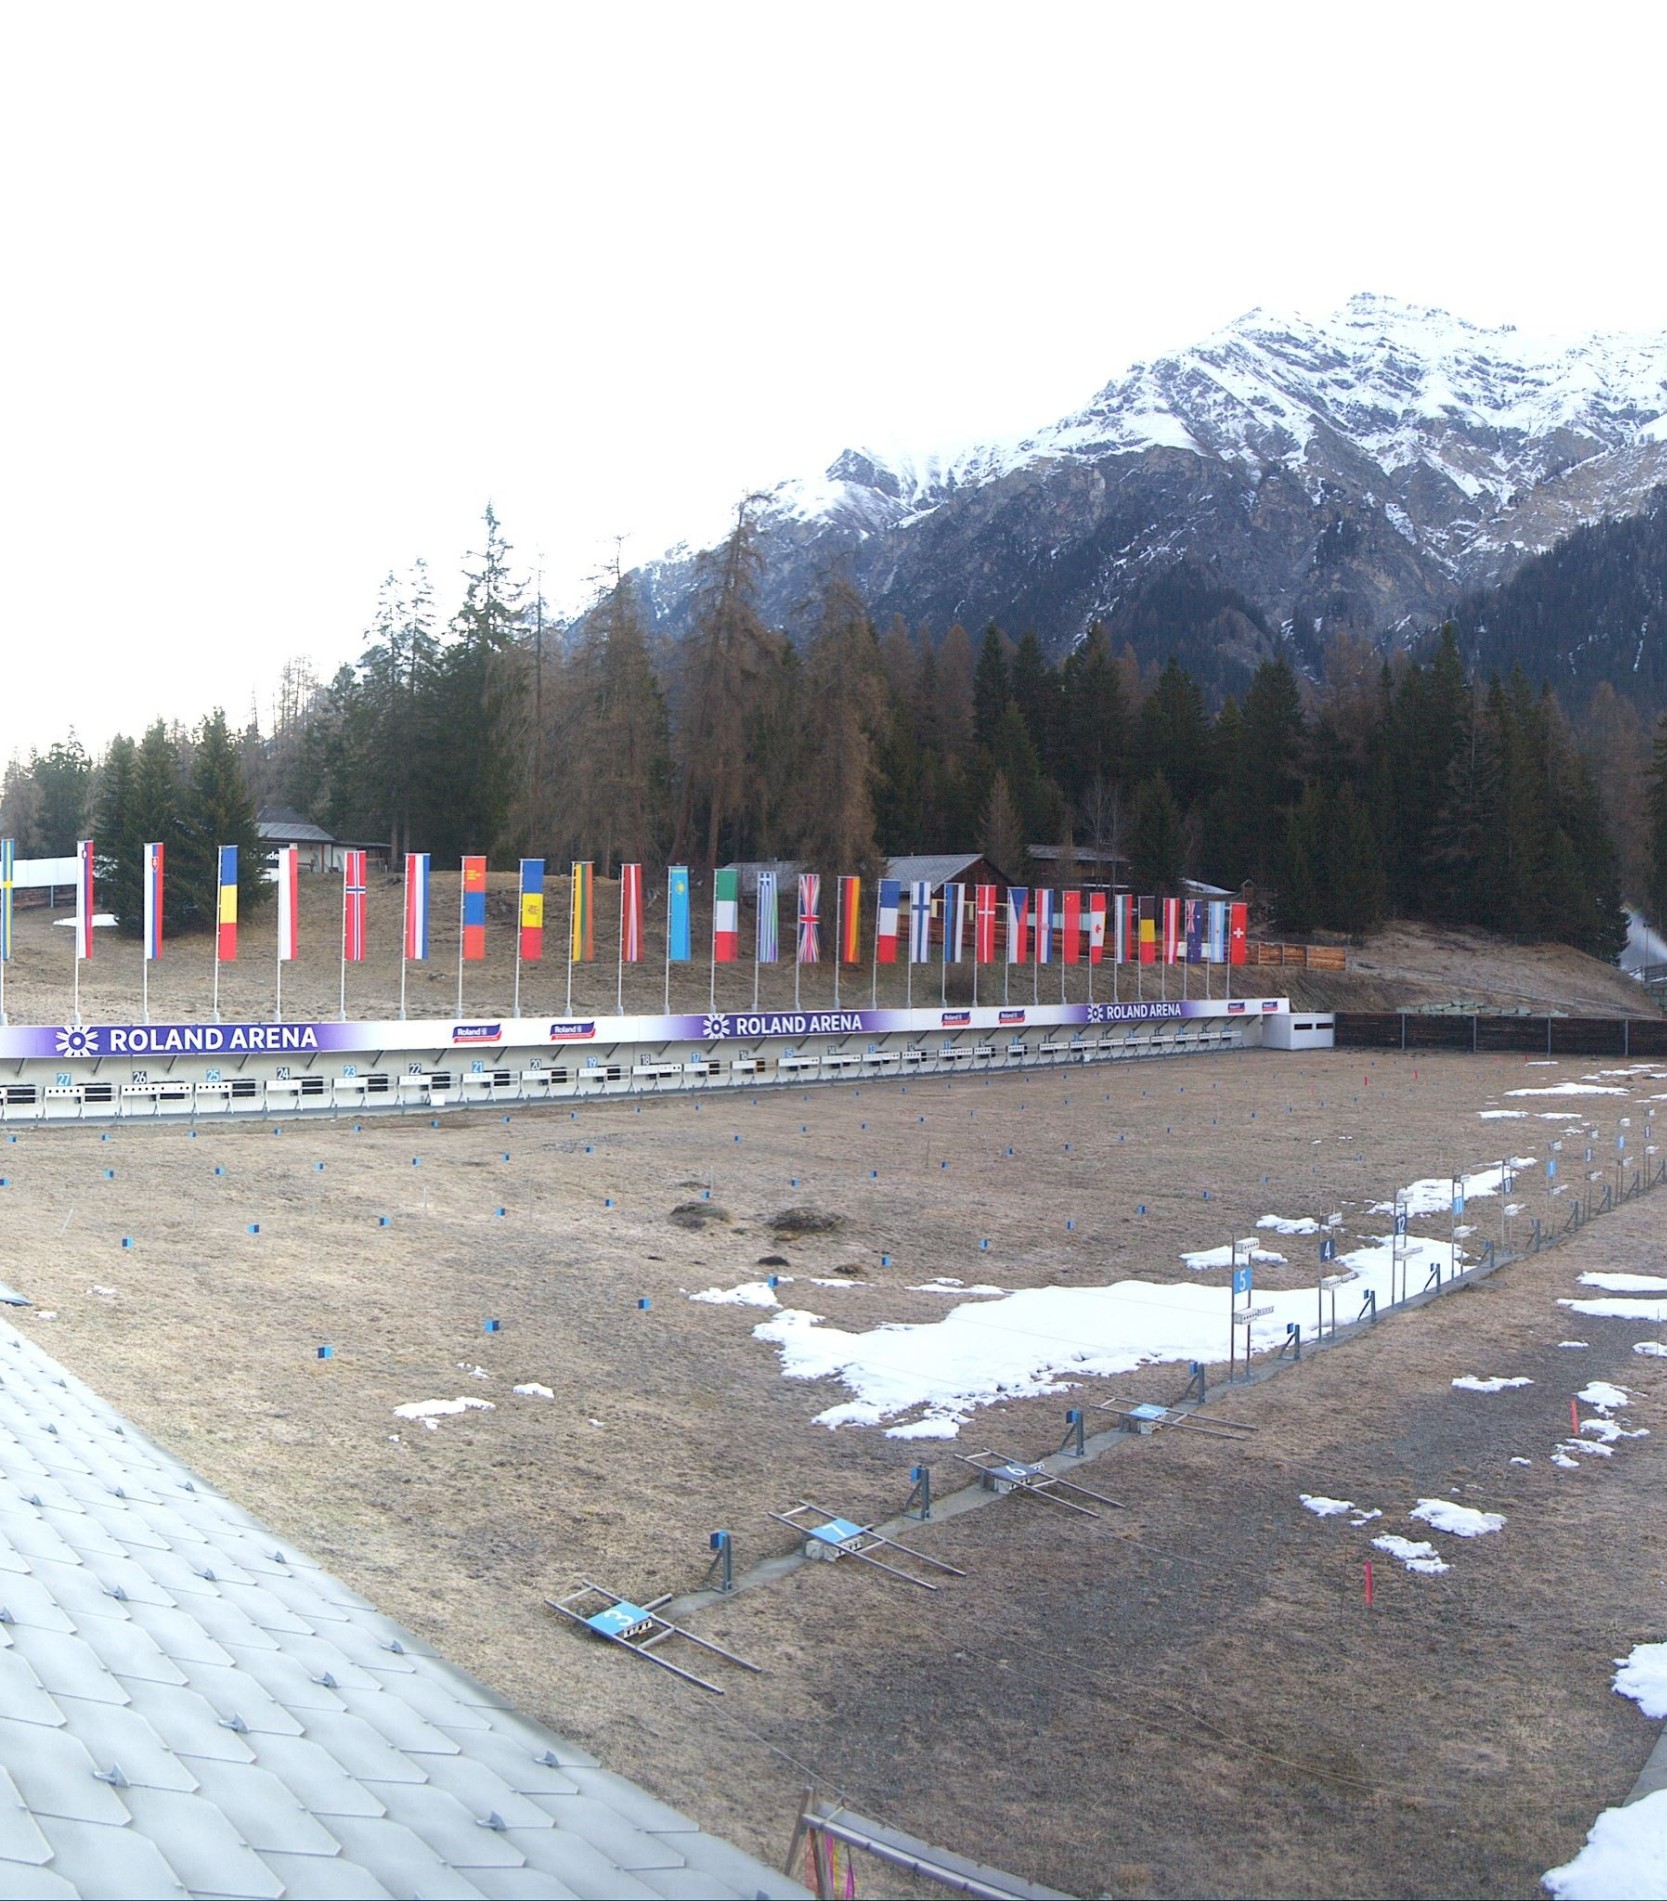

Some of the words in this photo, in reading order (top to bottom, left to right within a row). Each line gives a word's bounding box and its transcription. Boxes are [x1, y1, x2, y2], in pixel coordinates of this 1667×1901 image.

[1107, 1005, 1148, 1019] ROLAND
[1149, 1003, 1182, 1017] ARENA
[555, 1026, 576, 1034] Roland
[736, 1016, 806, 1035] ROLAND
[809, 1014, 863, 1032] ARENA
[457, 1028, 481, 1036] Roland
[110, 1028, 223, 1051] ROLAND
[229, 1027, 318, 1050] ARENA
[344, 1065, 356, 1077] 23
[410, 1064, 421, 1074] 22
[473, 1062, 483, 1072] 21
[58, 1074, 71, 1085] 27
[133, 1072, 147, 1084] 26
[207, 1070, 220, 1082] 25
[278, 1068, 289, 1080] 24
[1397, 1215, 1406, 1234] 12
[1324, 1240, 1332, 1260] 4
[1239, 1269, 1246, 1291] 5
[604, 1609, 635, 1627] 3
